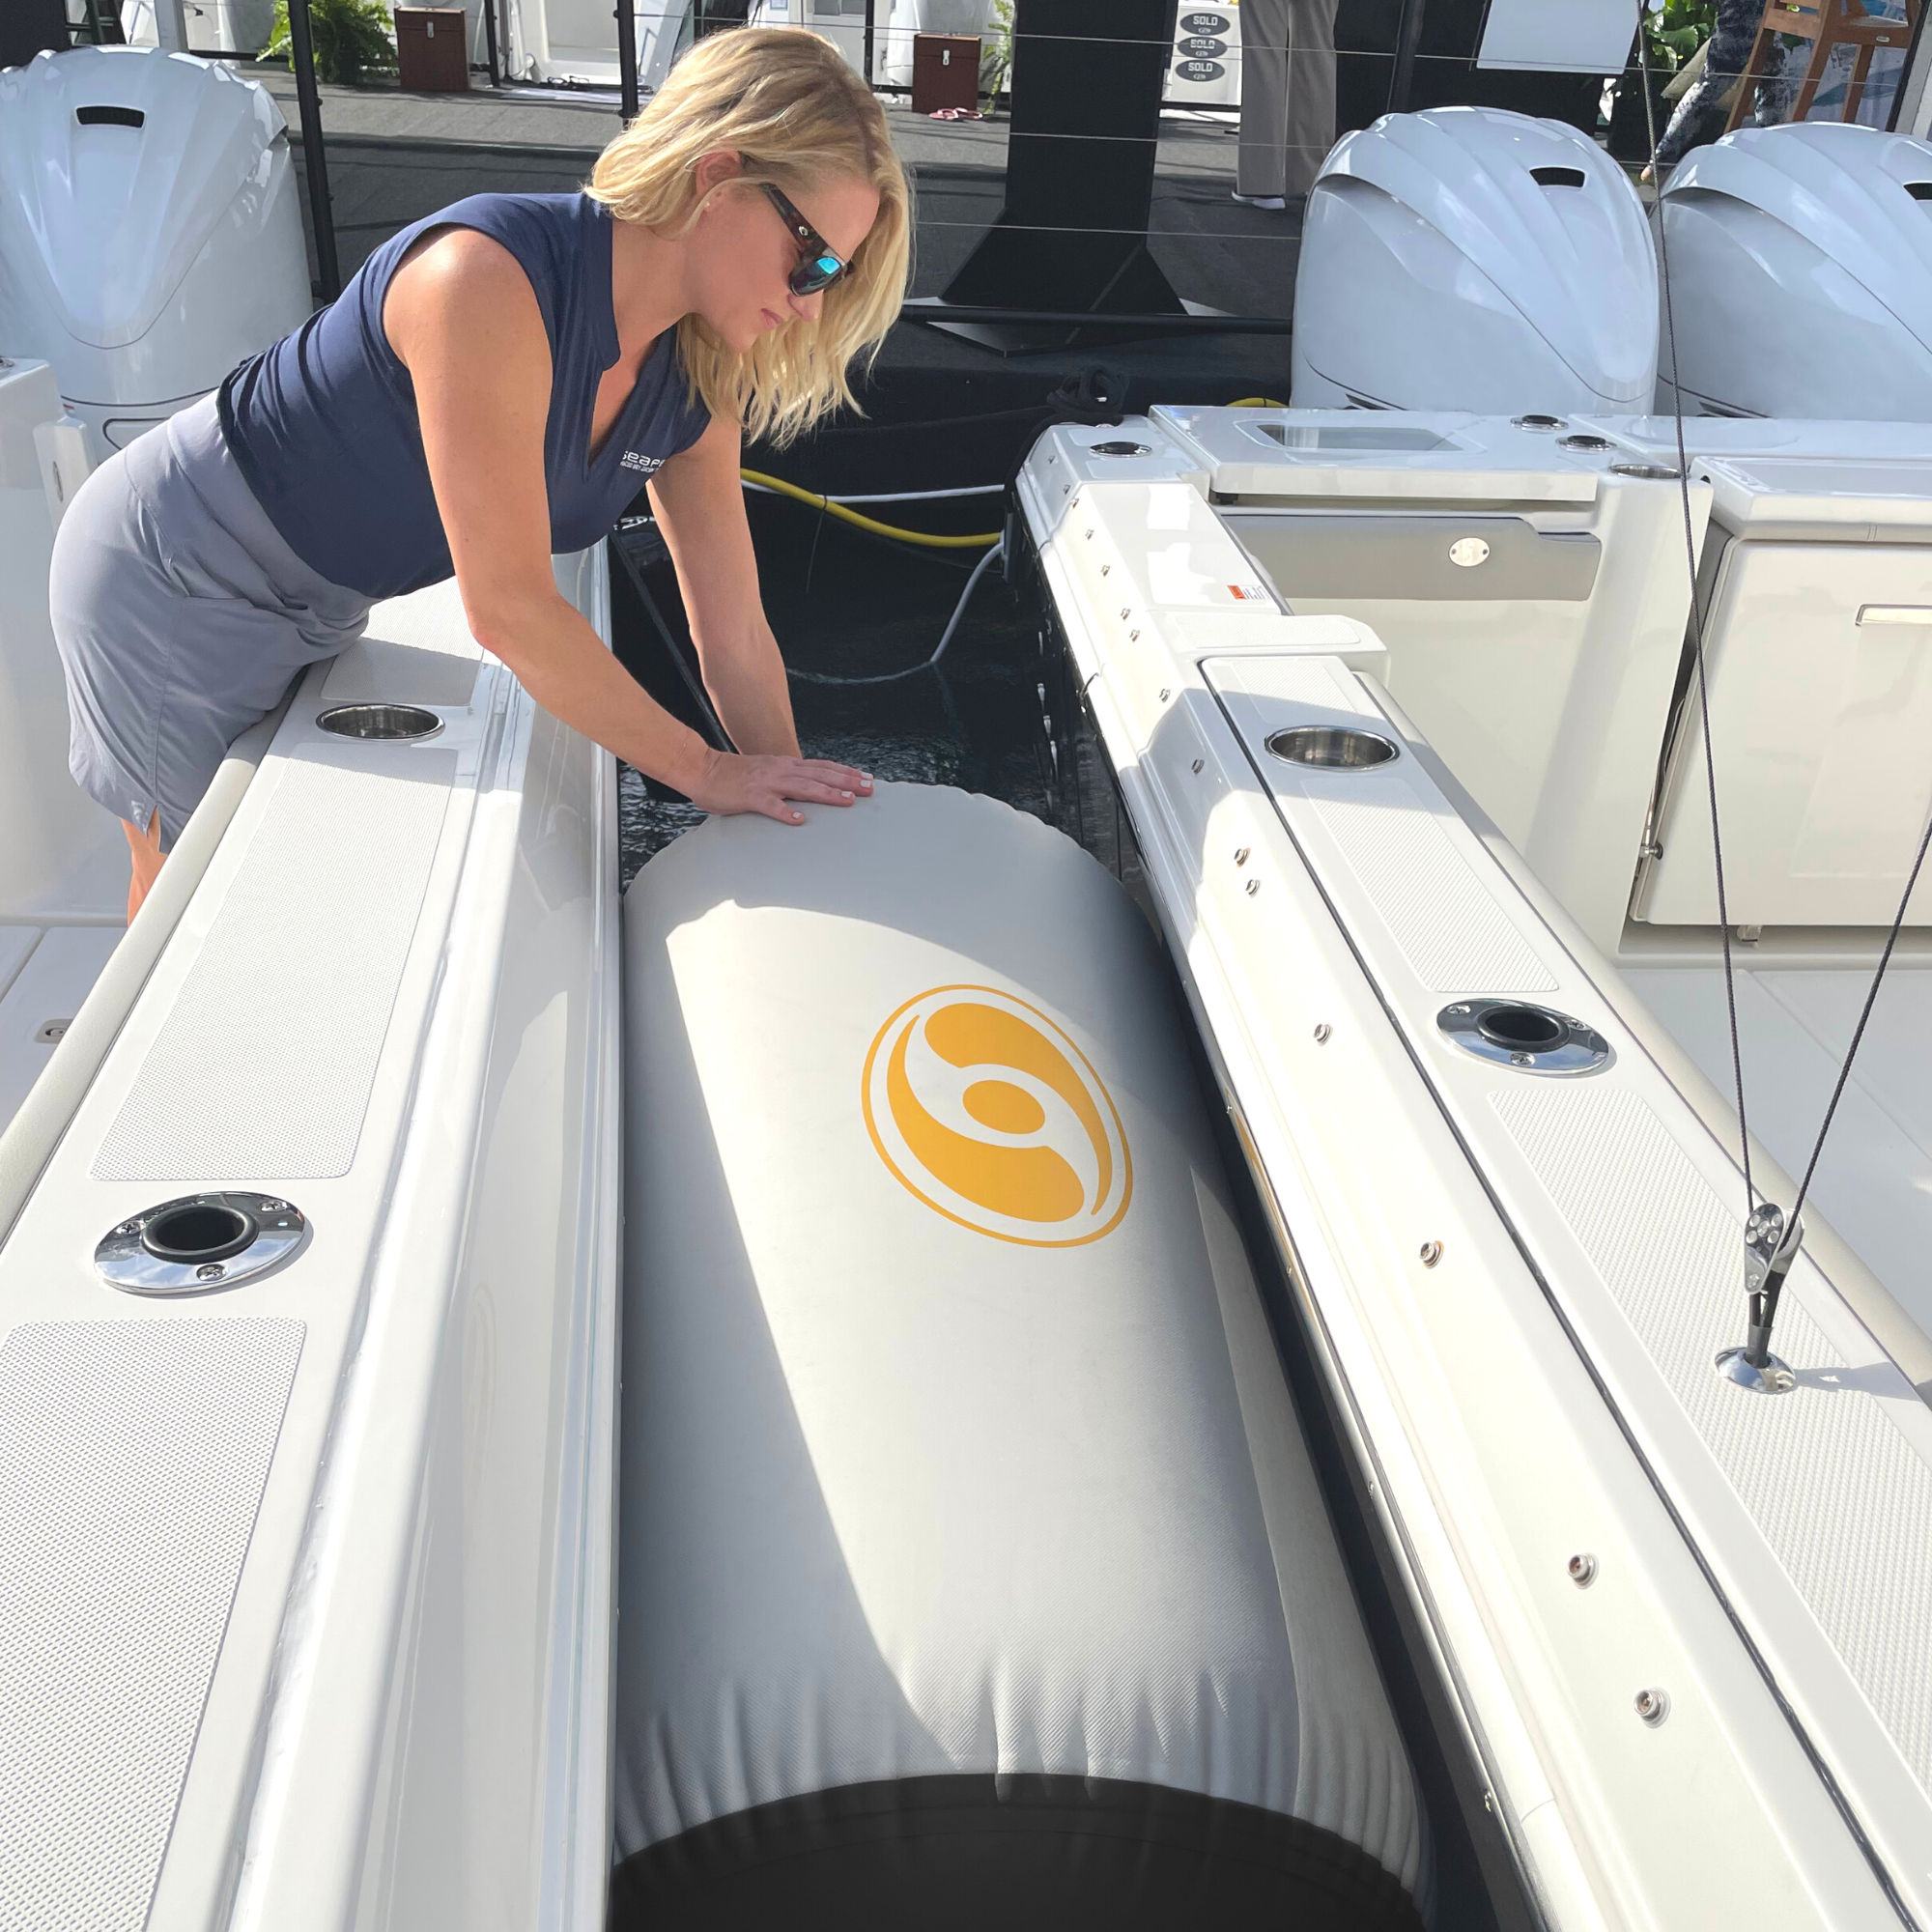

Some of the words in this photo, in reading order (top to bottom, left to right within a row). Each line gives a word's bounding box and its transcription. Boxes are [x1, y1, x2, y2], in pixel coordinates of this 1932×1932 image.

[1193, 15, 1218, 26] SOLD
[1190, 40, 1215, 49] SOLD
[1188, 63, 1213, 72] SOLD
